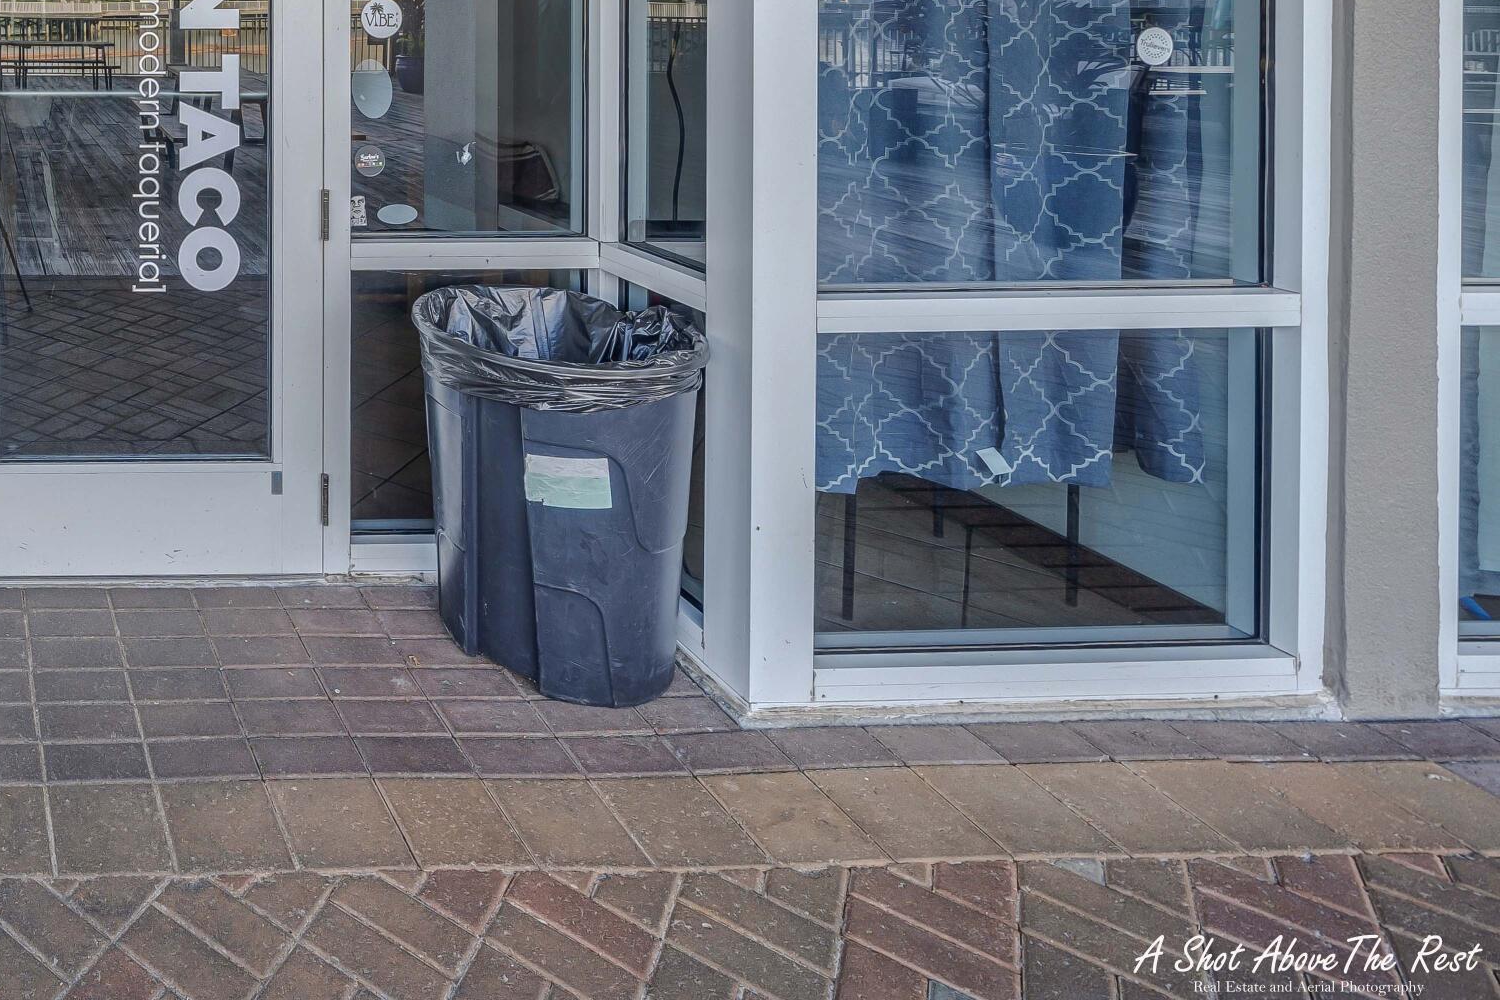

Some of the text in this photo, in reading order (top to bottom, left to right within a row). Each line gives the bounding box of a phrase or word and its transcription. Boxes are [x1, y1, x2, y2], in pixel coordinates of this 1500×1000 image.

[138, 0, 167, 129] modern
[364, 12, 397, 28] VIBE
[177, 53, 241, 292] TACO
